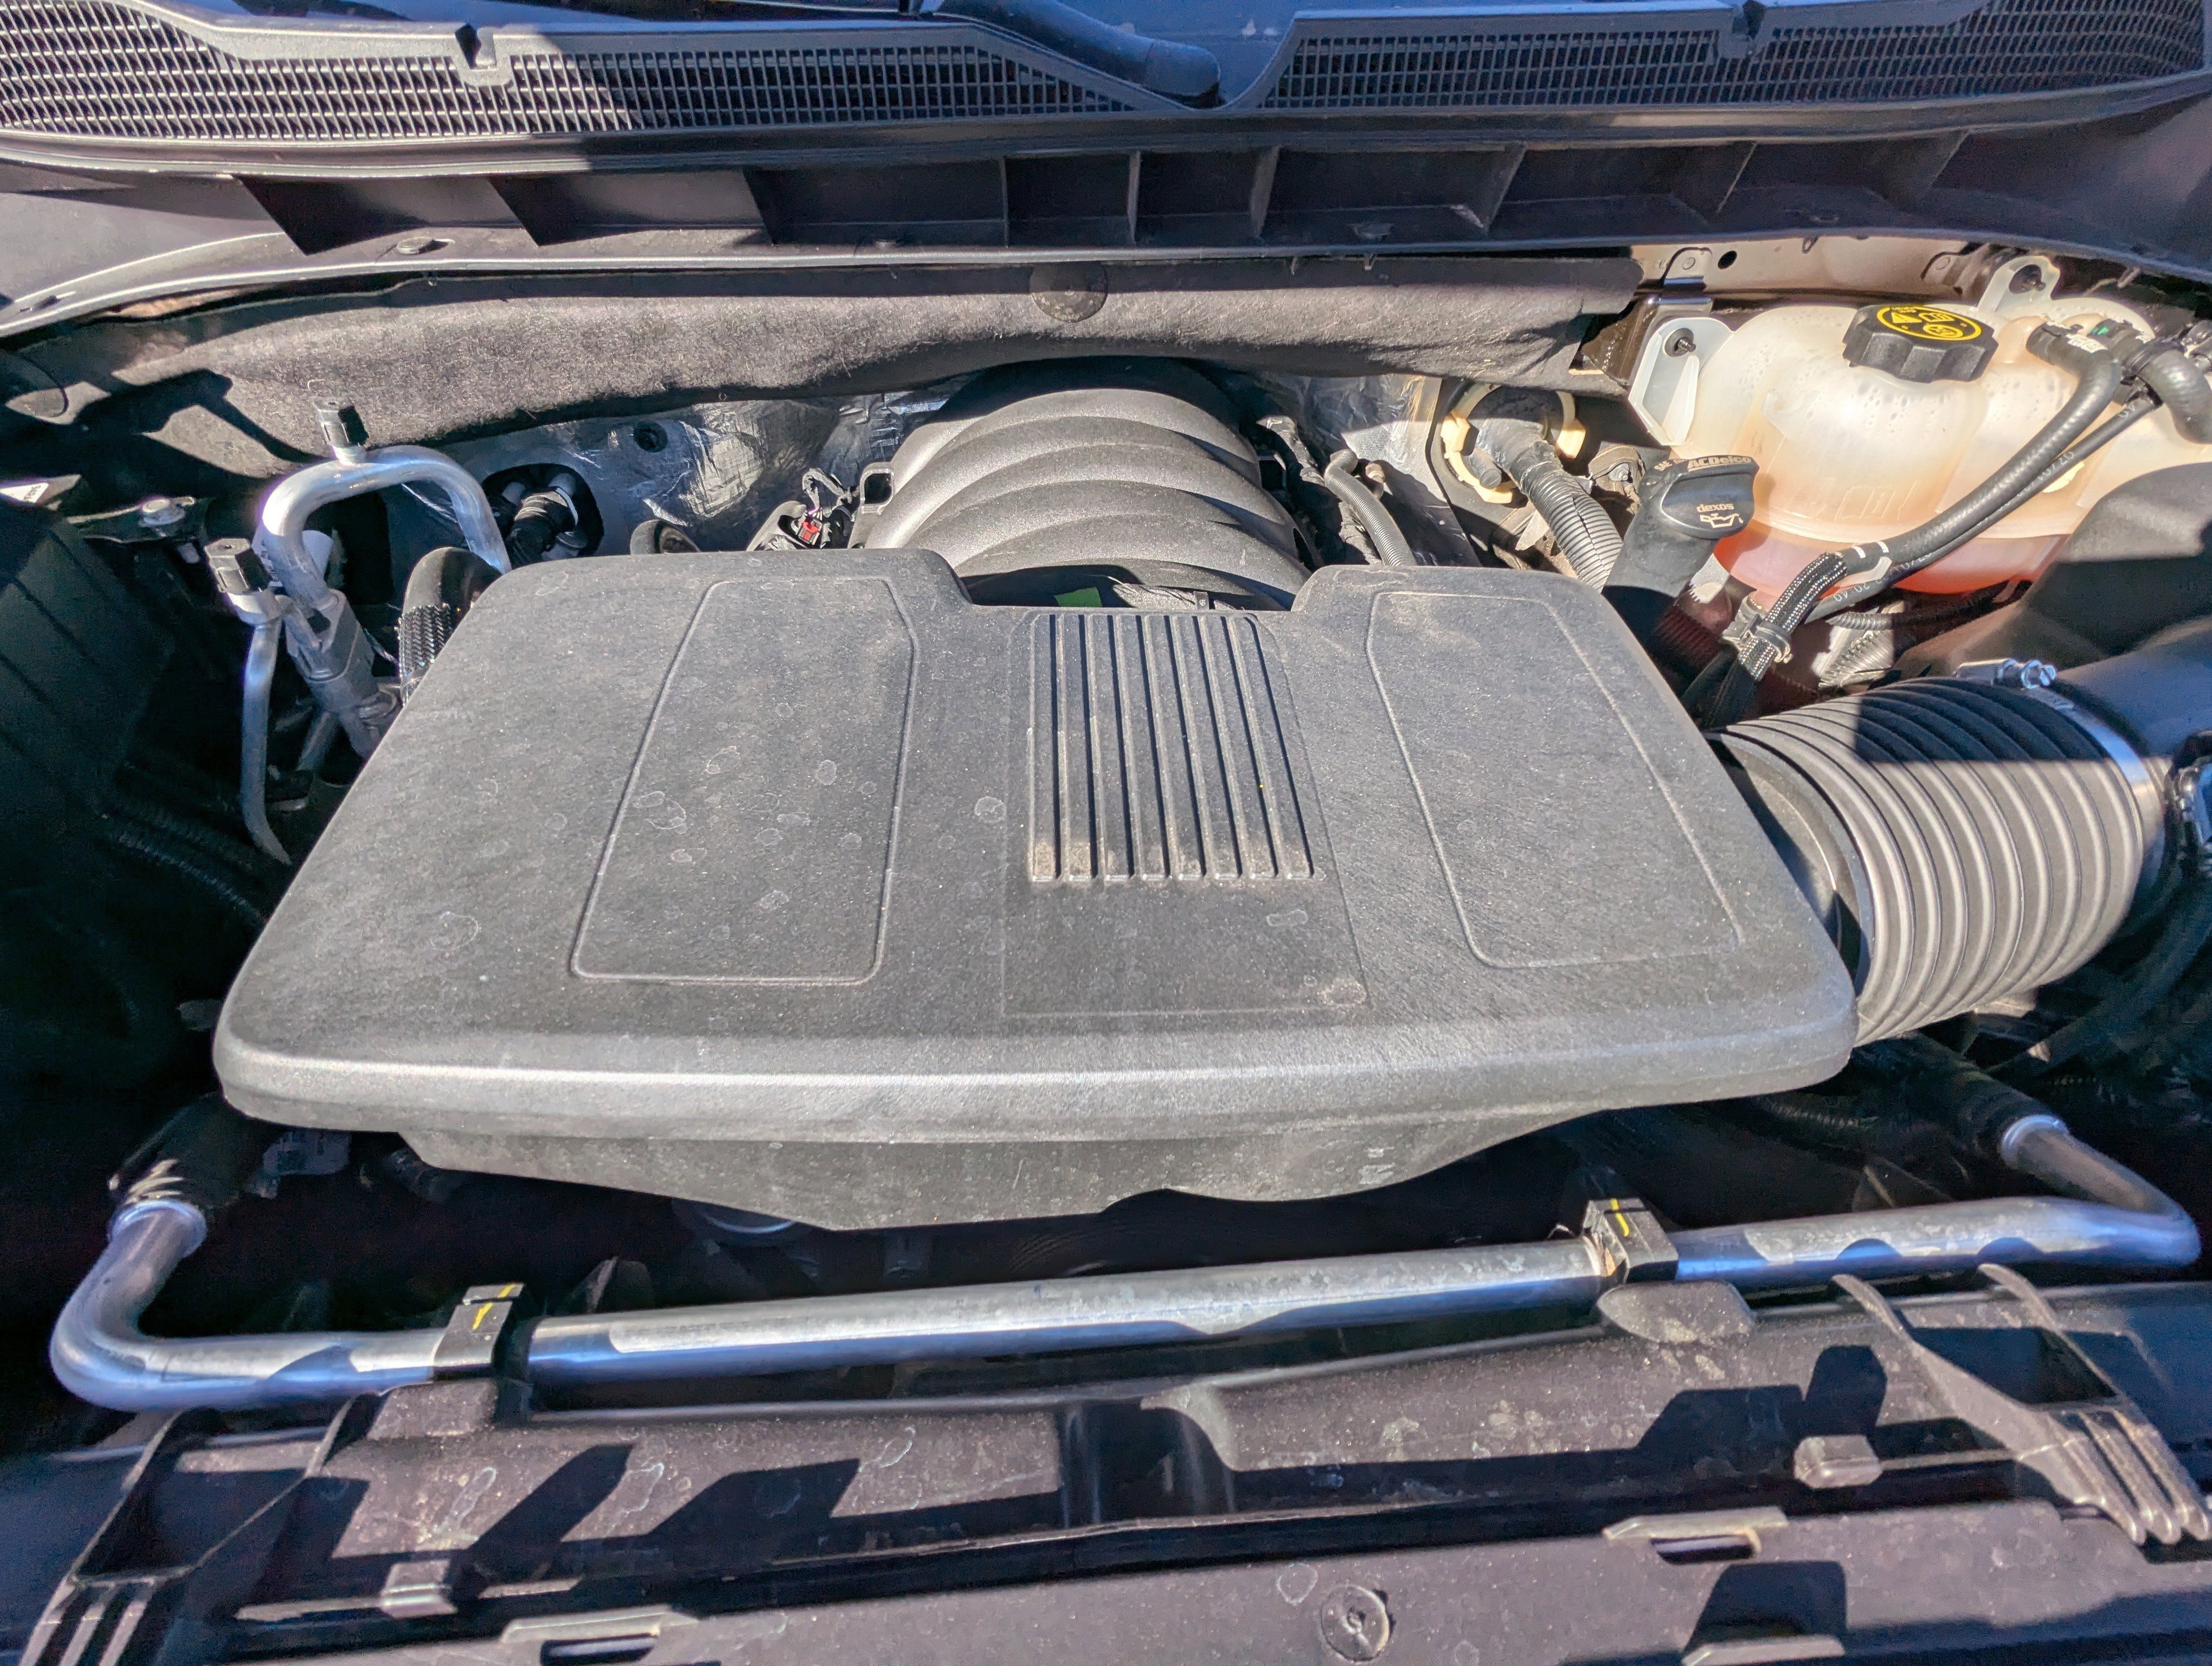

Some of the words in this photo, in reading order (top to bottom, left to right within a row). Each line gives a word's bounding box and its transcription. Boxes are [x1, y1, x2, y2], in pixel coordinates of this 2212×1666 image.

[1654, 460, 1673, 471] SAE
[1687, 455, 1752, 470] ACDelco
[1696, 503, 1735, 513] dexos
